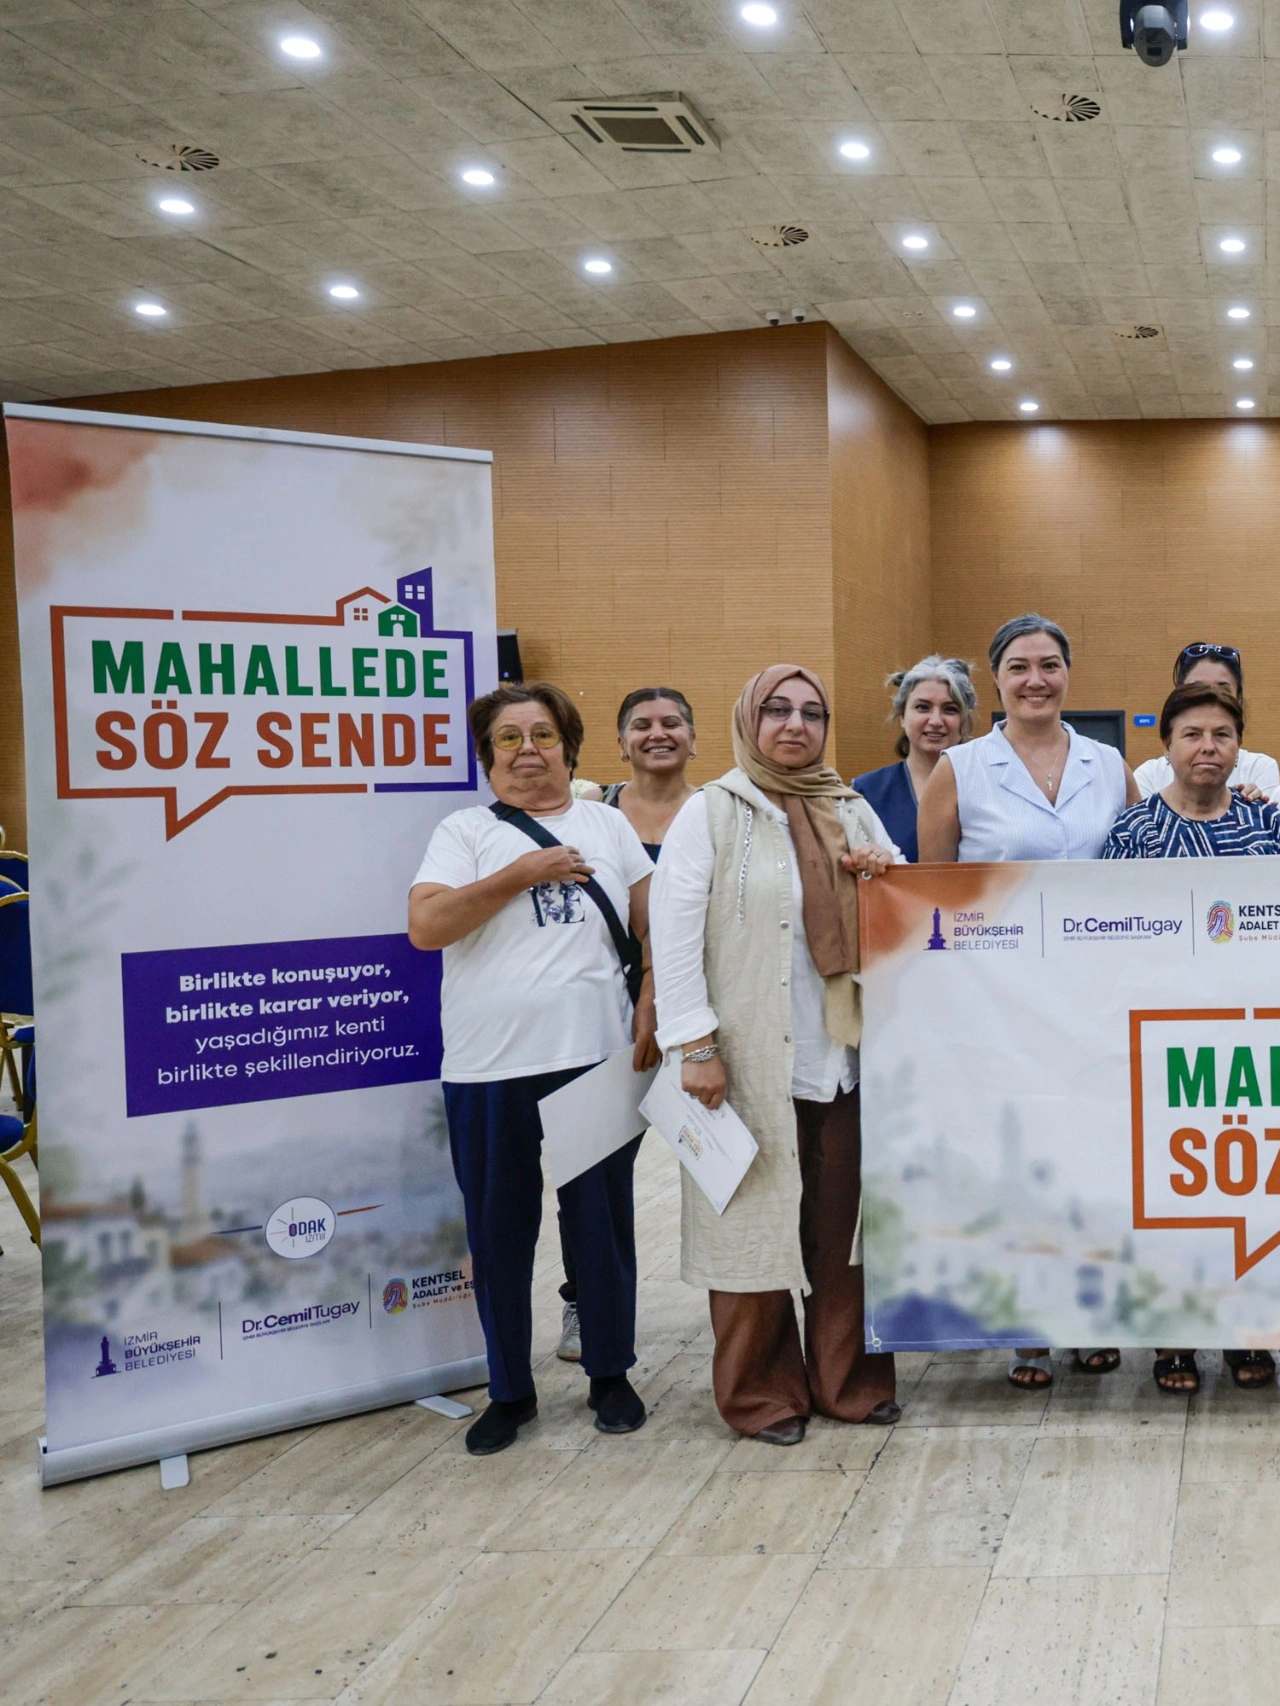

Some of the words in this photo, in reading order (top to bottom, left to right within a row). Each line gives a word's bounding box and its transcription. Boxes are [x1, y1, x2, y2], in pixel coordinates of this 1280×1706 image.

[91, 640, 450, 699] MAHALLEDE
[95, 700, 231, 771] SÖZ
[256, 711, 452, 769] SENDE
[953, 911, 985, 922] İZMİR
[1238, 920, 1279, 931] ADALET
[953, 926, 1024, 938] BÜYÜKŞEHİR
[953, 938, 1019, 950] BELEDİYESİ
[179, 971, 267, 993] Birlikte
[271, 963, 391, 984] konuşuyor,
[165, 1002, 254, 1024] birlikte
[259, 998, 323, 1015] karar
[327, 988, 409, 1008] veriyor,
[195, 1025, 329, 1054] yaşadığımız
[335, 1016, 386, 1036] kenti
[157, 1062, 238, 1086] birlikte
[244, 1044, 420, 1078] şekillendiriyoruz.
[288, 1217, 327, 1237] ODAK
[411, 1269, 466, 1289] KENTSEL
[411, 1285, 449, 1301] ADALET
[451, 1284, 462, 1292] ve
[124, 1331, 158, 1346] İZMİR
[124, 1335, 201, 1360] BÜYÜKŞEHİR
[125, 1348, 196, 1372] BELEDİYESİ
